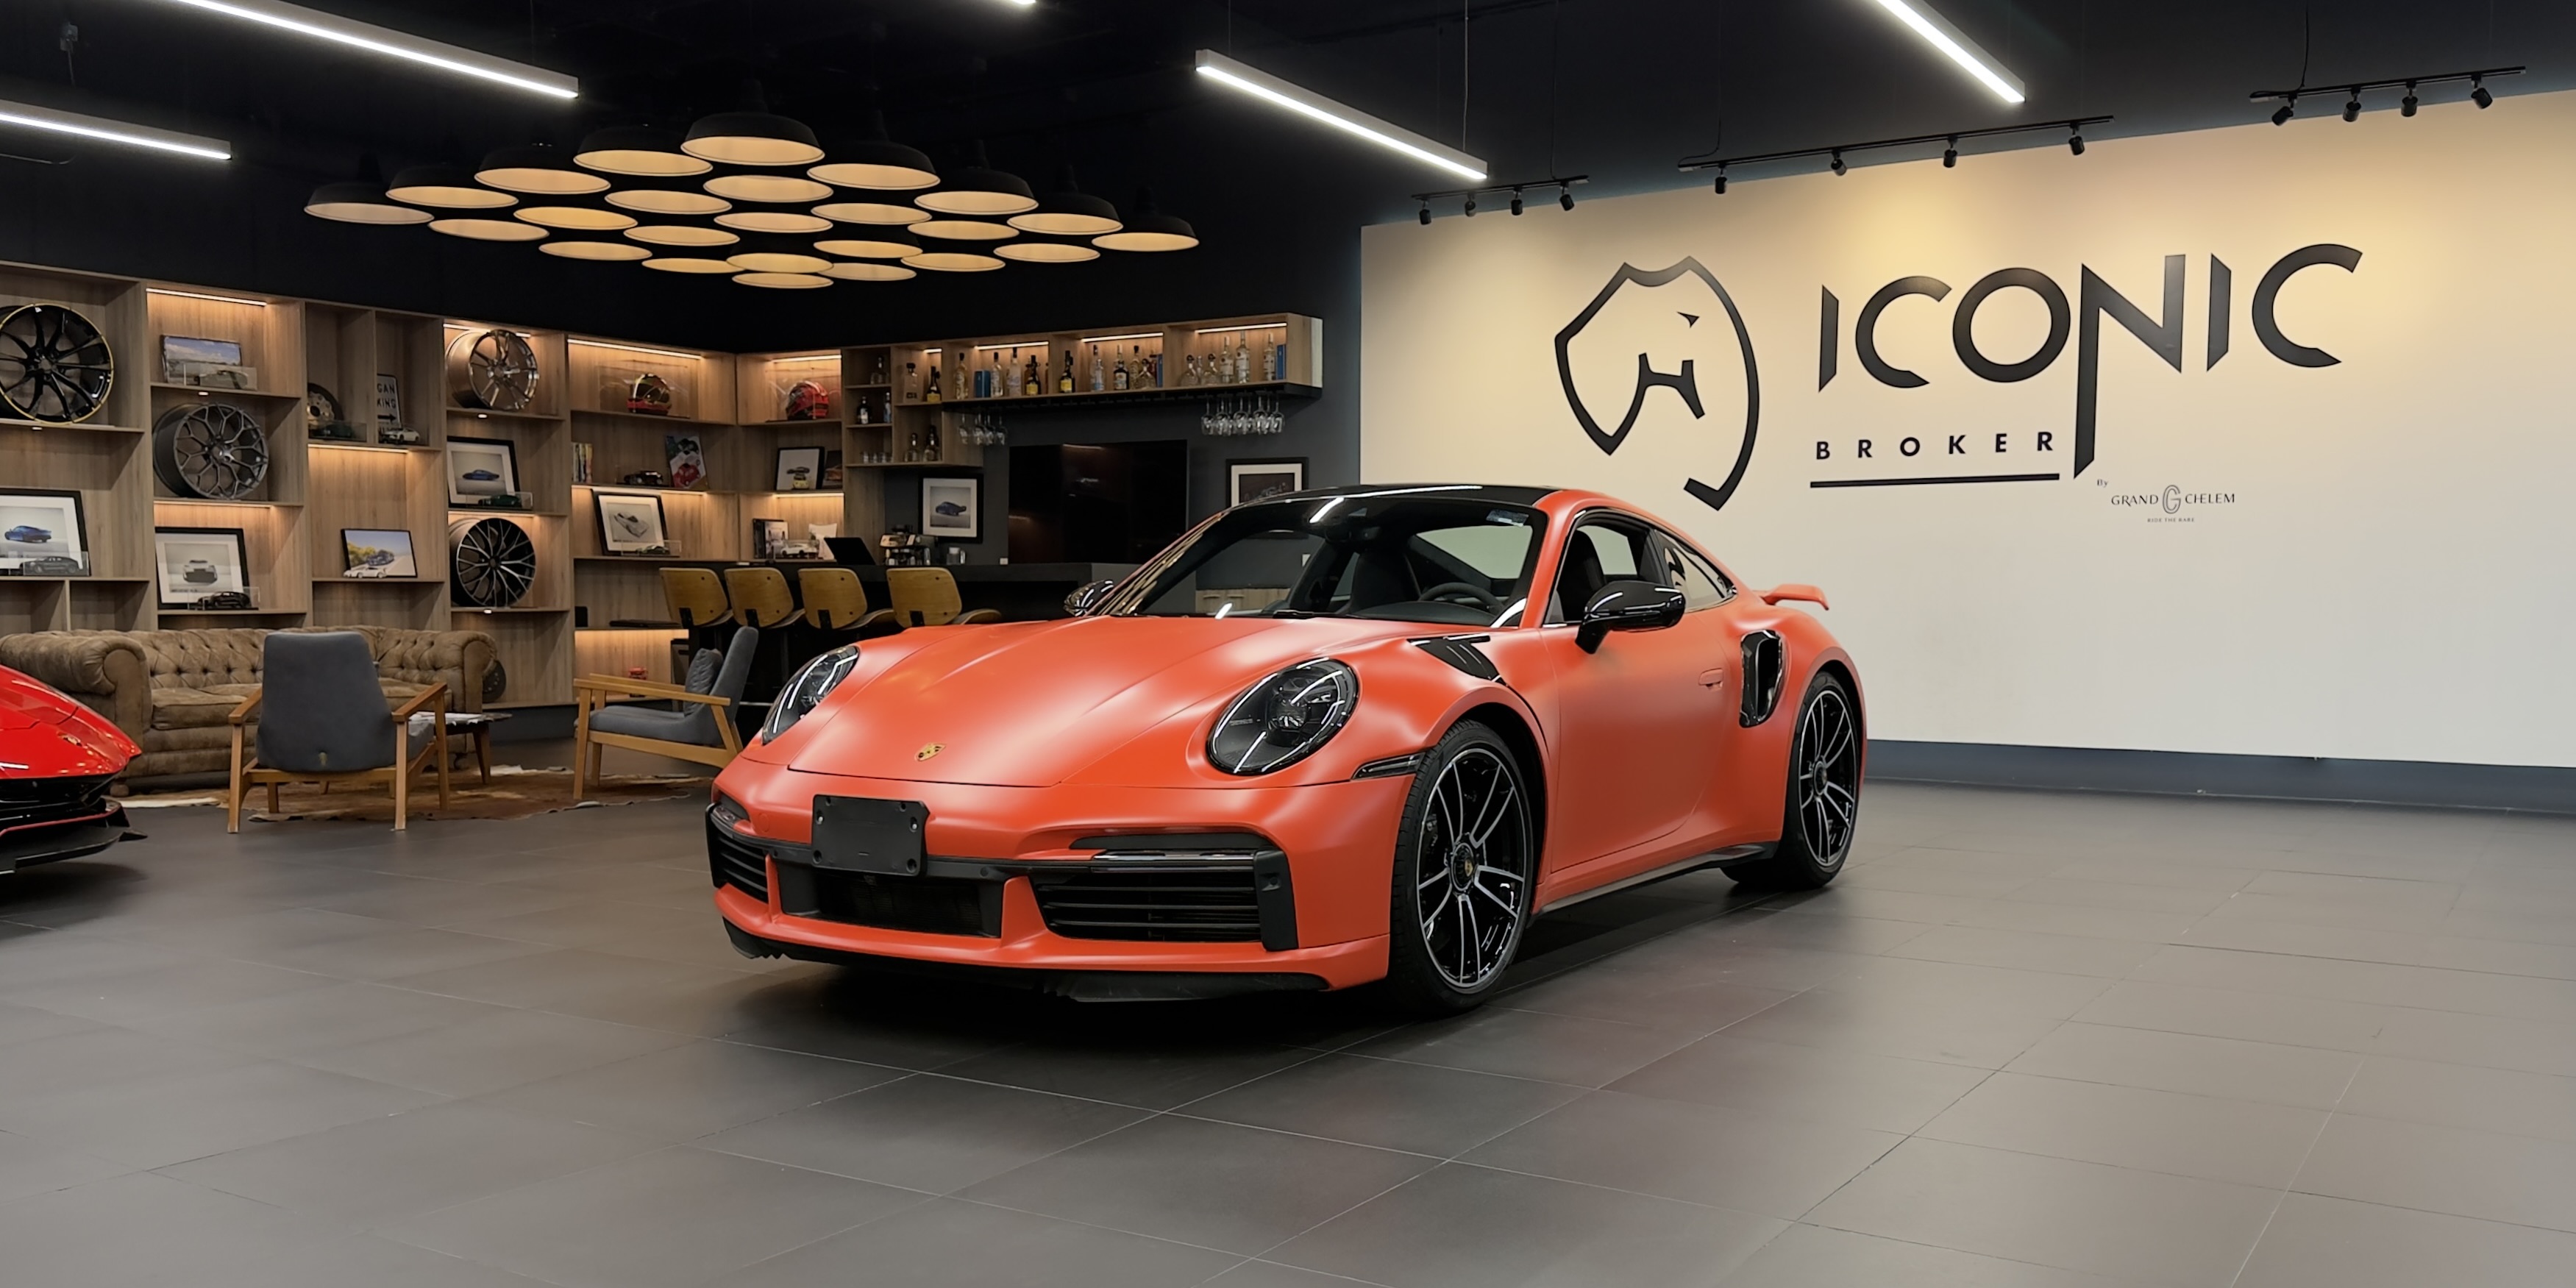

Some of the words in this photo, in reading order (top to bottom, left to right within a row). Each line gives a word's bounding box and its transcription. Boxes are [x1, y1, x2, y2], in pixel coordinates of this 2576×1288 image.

[1818, 243, 2363, 478] ICONIC
[1816, 431, 2054, 460] BROKER
[2096, 478, 2108, 488] By
[2110, 494, 2159, 507] GRAND
[2185, 493, 2235, 504] CHELEM
